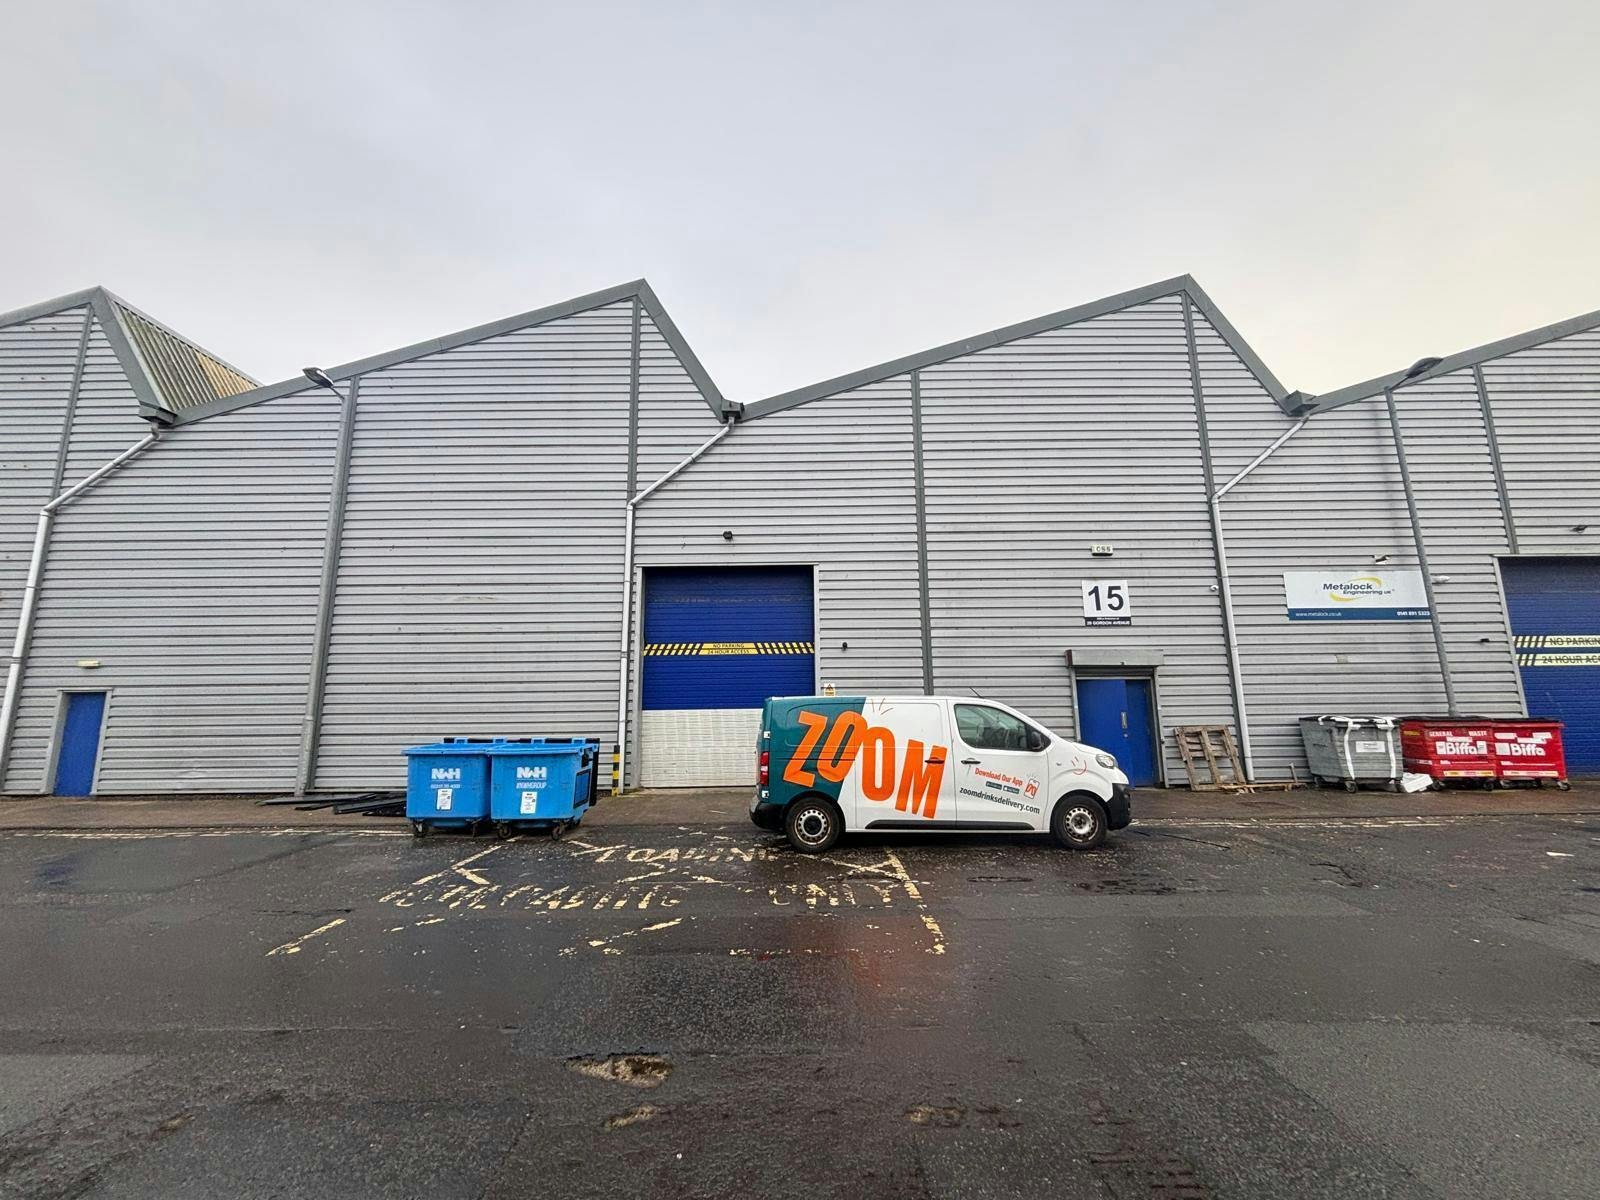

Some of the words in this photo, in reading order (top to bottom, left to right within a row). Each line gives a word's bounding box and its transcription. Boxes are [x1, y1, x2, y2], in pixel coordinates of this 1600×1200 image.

[1088, 586, 1124, 611] 15
[1550, 637, 1564, 646] NO
[1542, 655, 1553, 664] 24
[1555, 655, 1583, 664] HOUR
[1446, 743, 1478, 754] Biffa
[1510, 743, 1545, 755] Biffa
[783, 710, 948, 819] ZOOM
[516, 767, 547, 778] NWH
[975, 767, 1001, 780] Download
[1001, 774, 1011, 782] Our
[1012, 776, 1023, 786] App
[960, 787, 1040, 814] zoomdrinksdelivery.com
